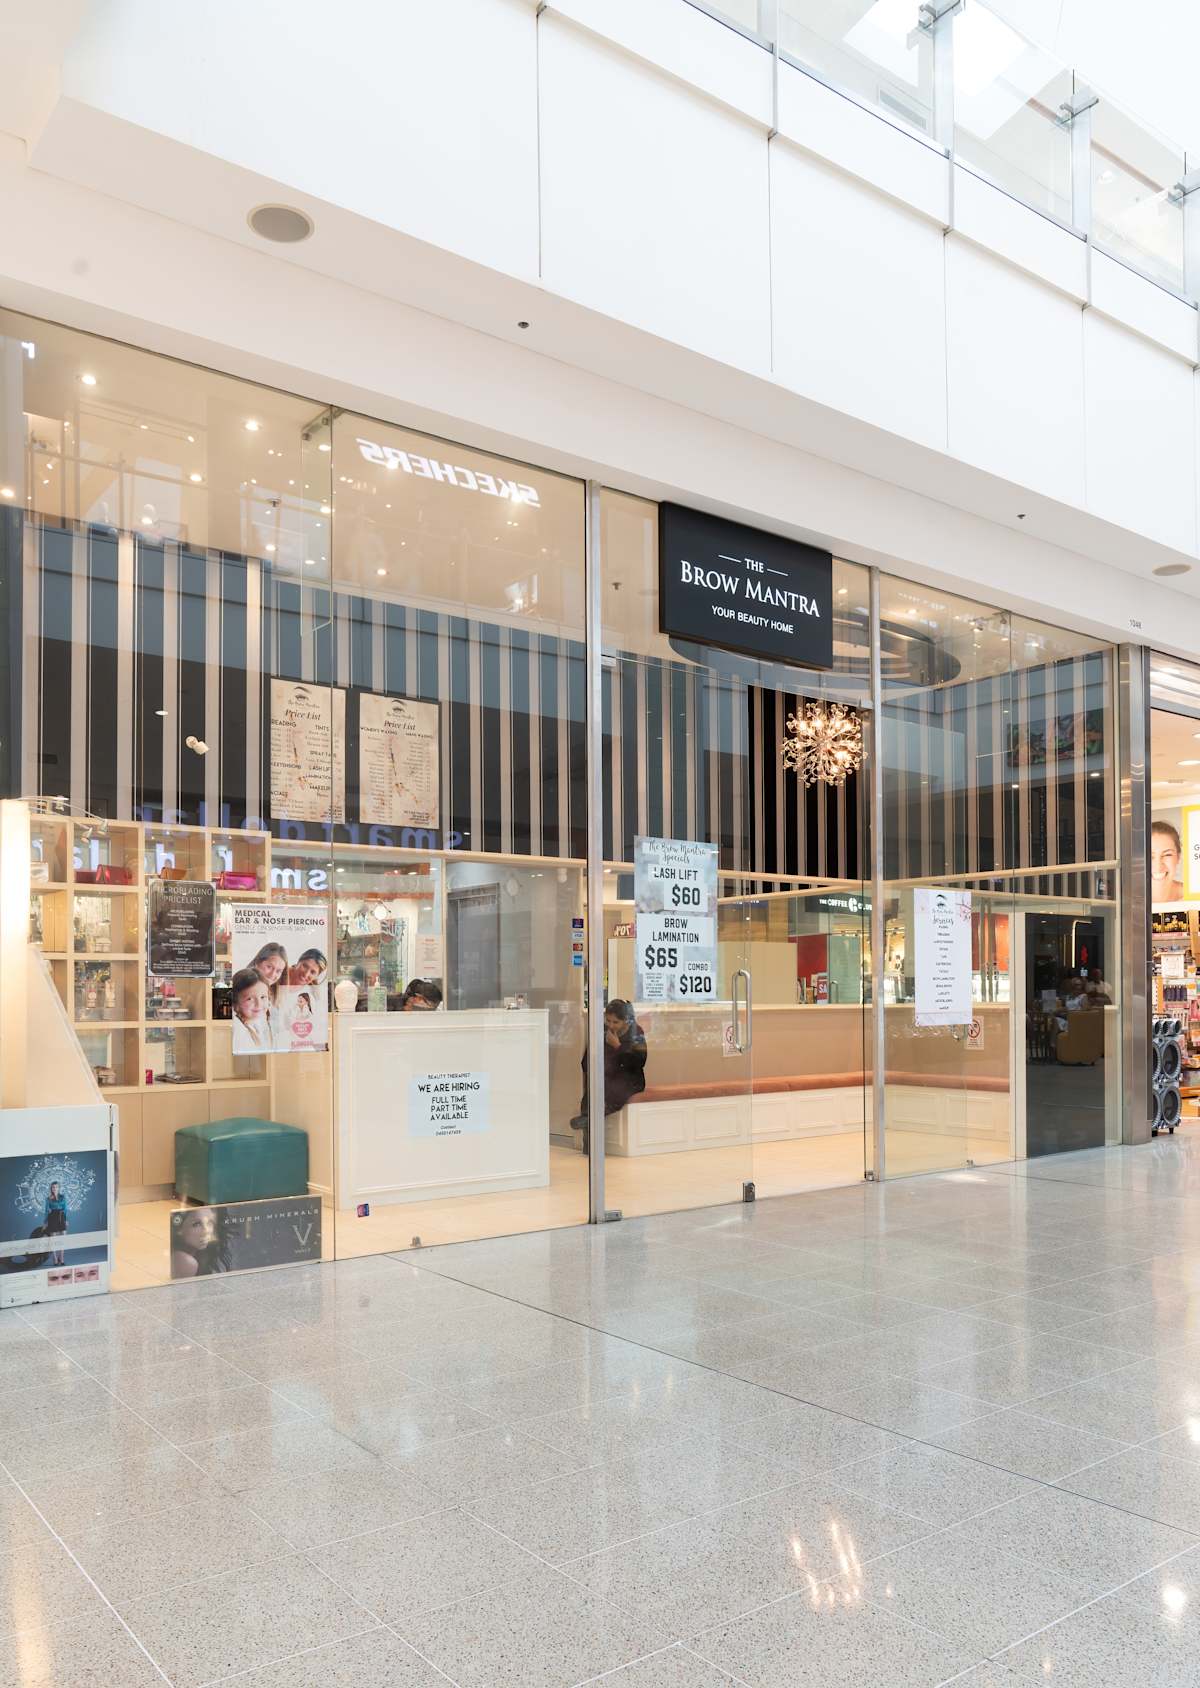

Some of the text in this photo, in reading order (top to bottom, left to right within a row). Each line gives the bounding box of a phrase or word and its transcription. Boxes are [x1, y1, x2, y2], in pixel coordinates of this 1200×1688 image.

[744, 558, 764, 574] THE
[712, 605, 794, 634] YOUR BEAUTY HOME
[654, 866, 698, 881] LASH LIFT
[672, 884, 700, 906] $60
[288, 918, 325, 926] PIERCING
[664, 918, 688, 928] BROW
[653, 932, 699, 943] LAMINATION
[645, 945, 678, 970] $65
[680, 974, 711, 994] $120
[418, 1082, 480, 1092] WE ARE HIRING
[432, 1095, 466, 1104] FULL TIME
[431, 1112, 469, 1120] AVAILABLE
